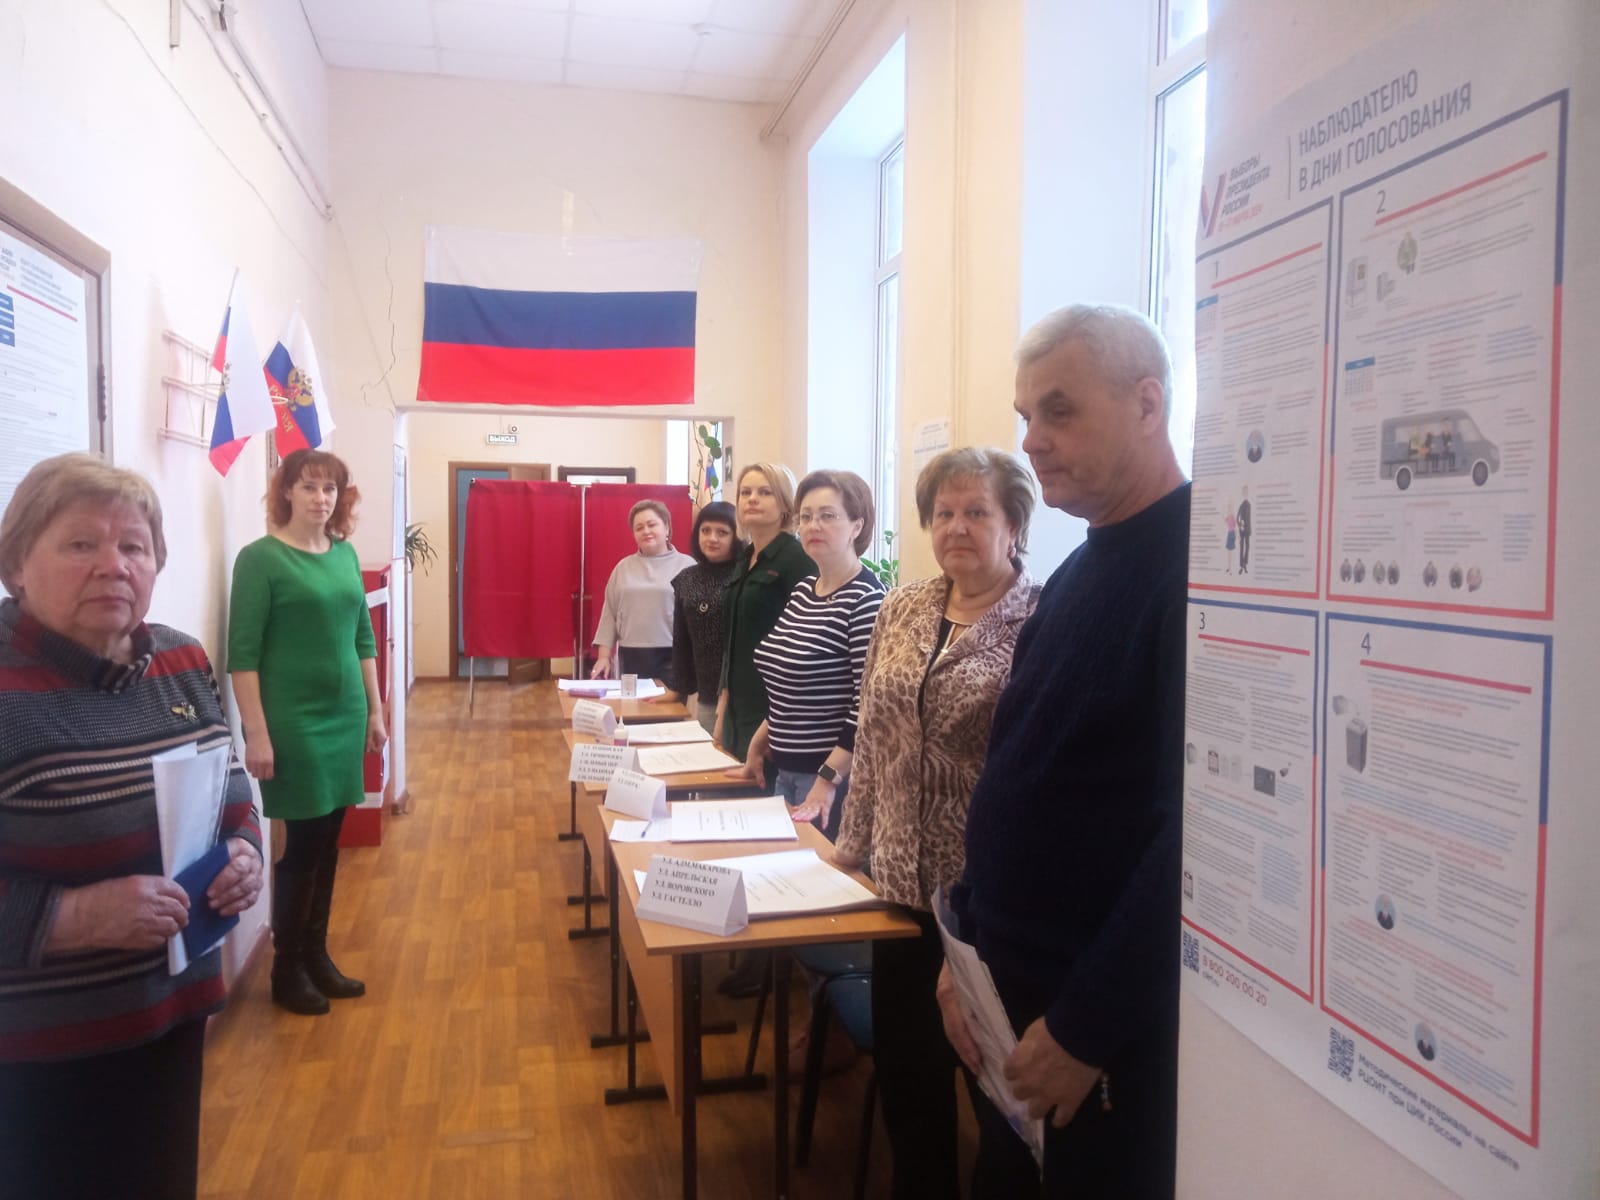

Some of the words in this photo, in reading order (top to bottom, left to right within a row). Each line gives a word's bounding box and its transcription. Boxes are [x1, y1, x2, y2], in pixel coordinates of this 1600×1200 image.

[1299, 69, 1418, 155] НАБЛЮДАТЕЛЮ
[1299, 166, 1308, 192] В
[1311, 148, 1342, 190] ДНИ
[1347, 80, 1472, 169] ГОЛОСОВАНИЯ
[1375, 190, 1387, 214] 2
[1214, 260, 1220, 278] 1
[1199, 612, 1206, 630] 3
[1360, 632, 1372, 655] 4
[672, 870, 719, 885] АПРЕЛЬСКАЯ
[667, 882, 716, 897] ВОРОВСКОГО
[664, 893, 703, 908] ГАСТЕЛЛО
[1209, 960, 1224, 977] 800
[1225, 969, 1240, 989] 200
[1242, 981, 1254, 997] 00
[1255, 991, 1267, 1007] 20
